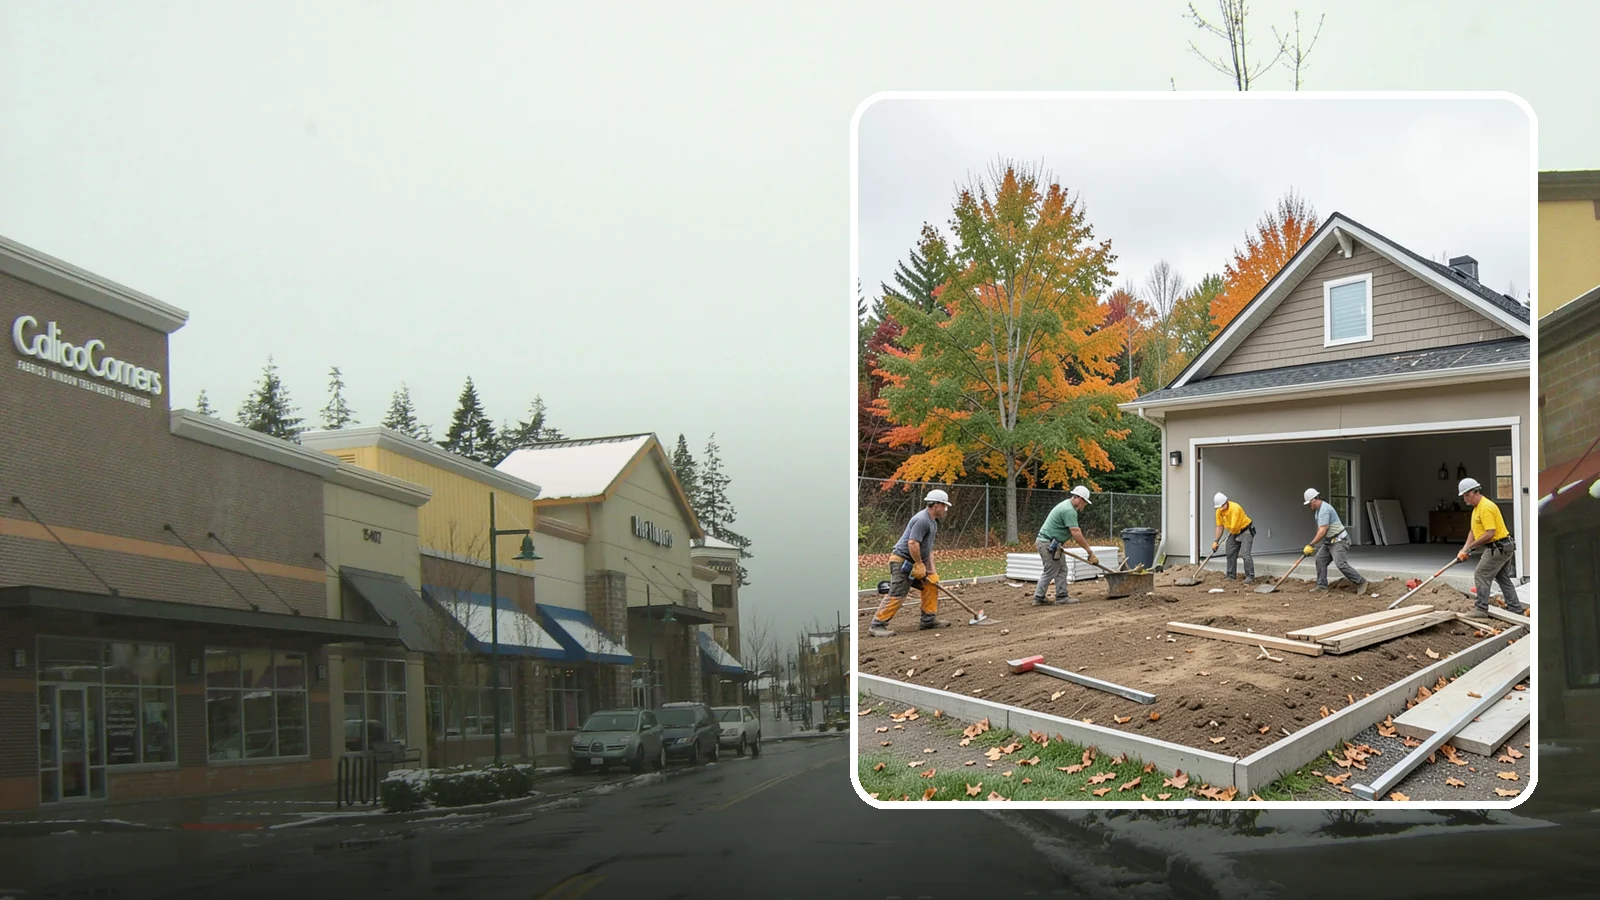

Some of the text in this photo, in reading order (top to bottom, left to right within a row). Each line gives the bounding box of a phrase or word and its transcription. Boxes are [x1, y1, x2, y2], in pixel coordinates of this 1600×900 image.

[17, 360, 47, 377] FABRICS
[52, 370, 78, 386] WINDOW
[79, 378, 116, 398] TREATMENTS
